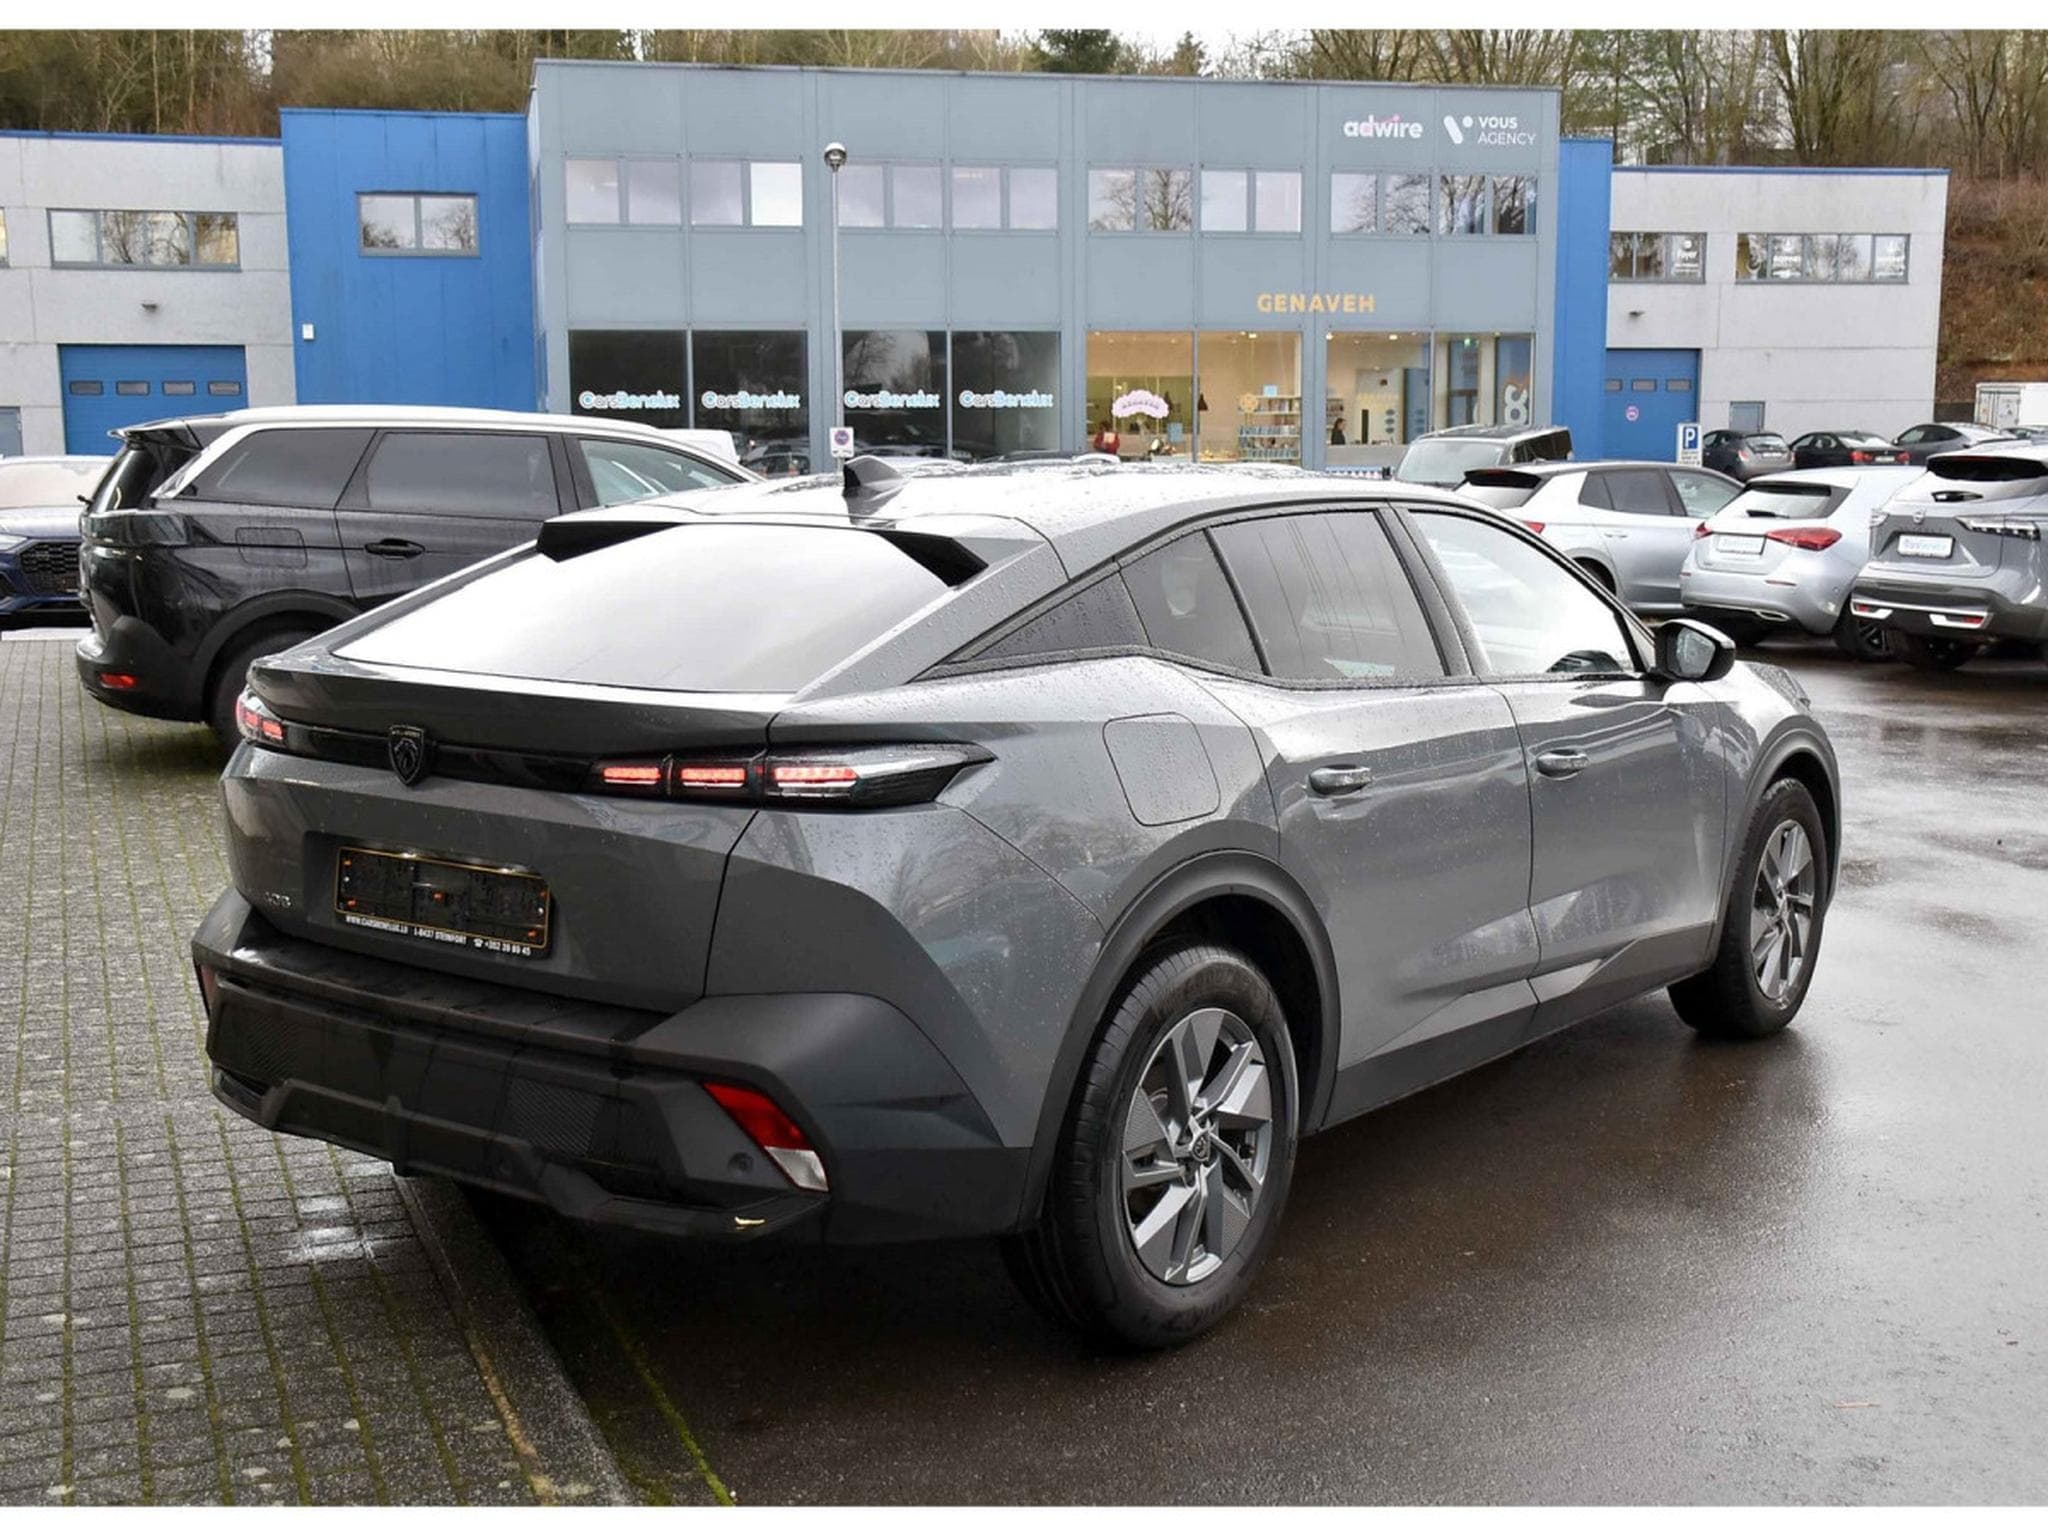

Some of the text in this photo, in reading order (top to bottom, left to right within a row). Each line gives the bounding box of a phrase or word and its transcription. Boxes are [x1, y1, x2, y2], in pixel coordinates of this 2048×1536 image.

[1343, 114, 1424, 139] adwire
[1478, 116, 1518, 129] VOUS
[1477, 132, 1537, 146] AGENCY
[1256, 292, 1376, 313] GENAVEH
[579, 390, 680, 409] CarsBenelux
[701, 390, 800, 409] CarsBenelux
[844, 389, 940, 408] CarsBenelux
[959, 389, 1053, 408] CarsBenelux
[1685, 428, 1696, 448] P
